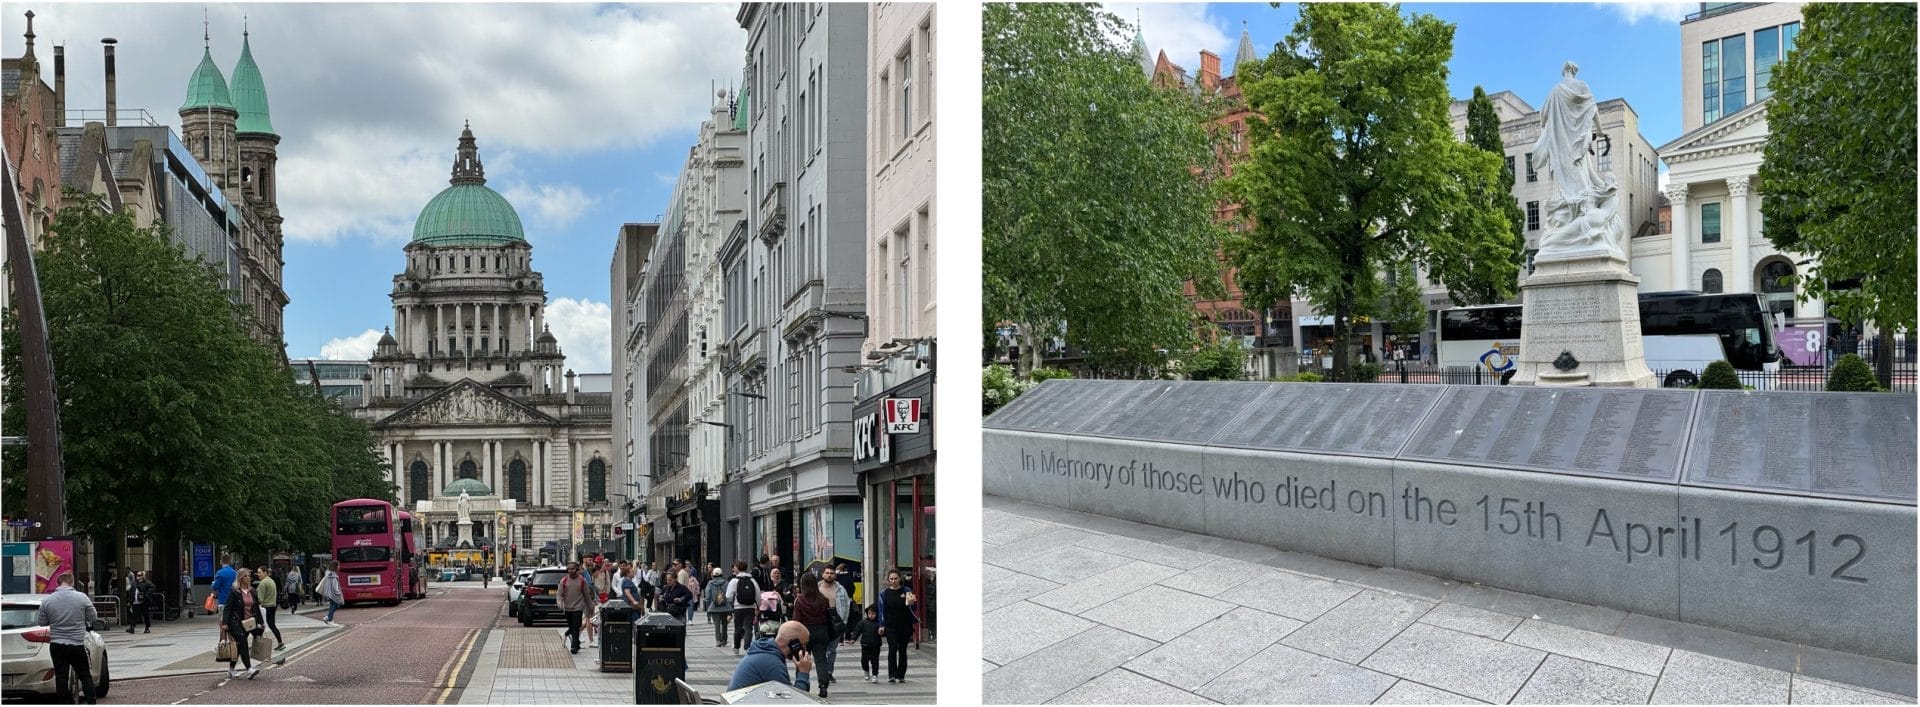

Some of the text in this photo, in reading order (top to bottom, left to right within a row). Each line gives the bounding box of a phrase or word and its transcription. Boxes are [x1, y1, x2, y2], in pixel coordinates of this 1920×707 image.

[1806, 330, 1821, 352] 8
[853, 412, 875, 461] KFC
[893, 423, 914, 431] KFC
[1021, 447, 1869, 584] In Memory of those who died on the 15th April 1912
